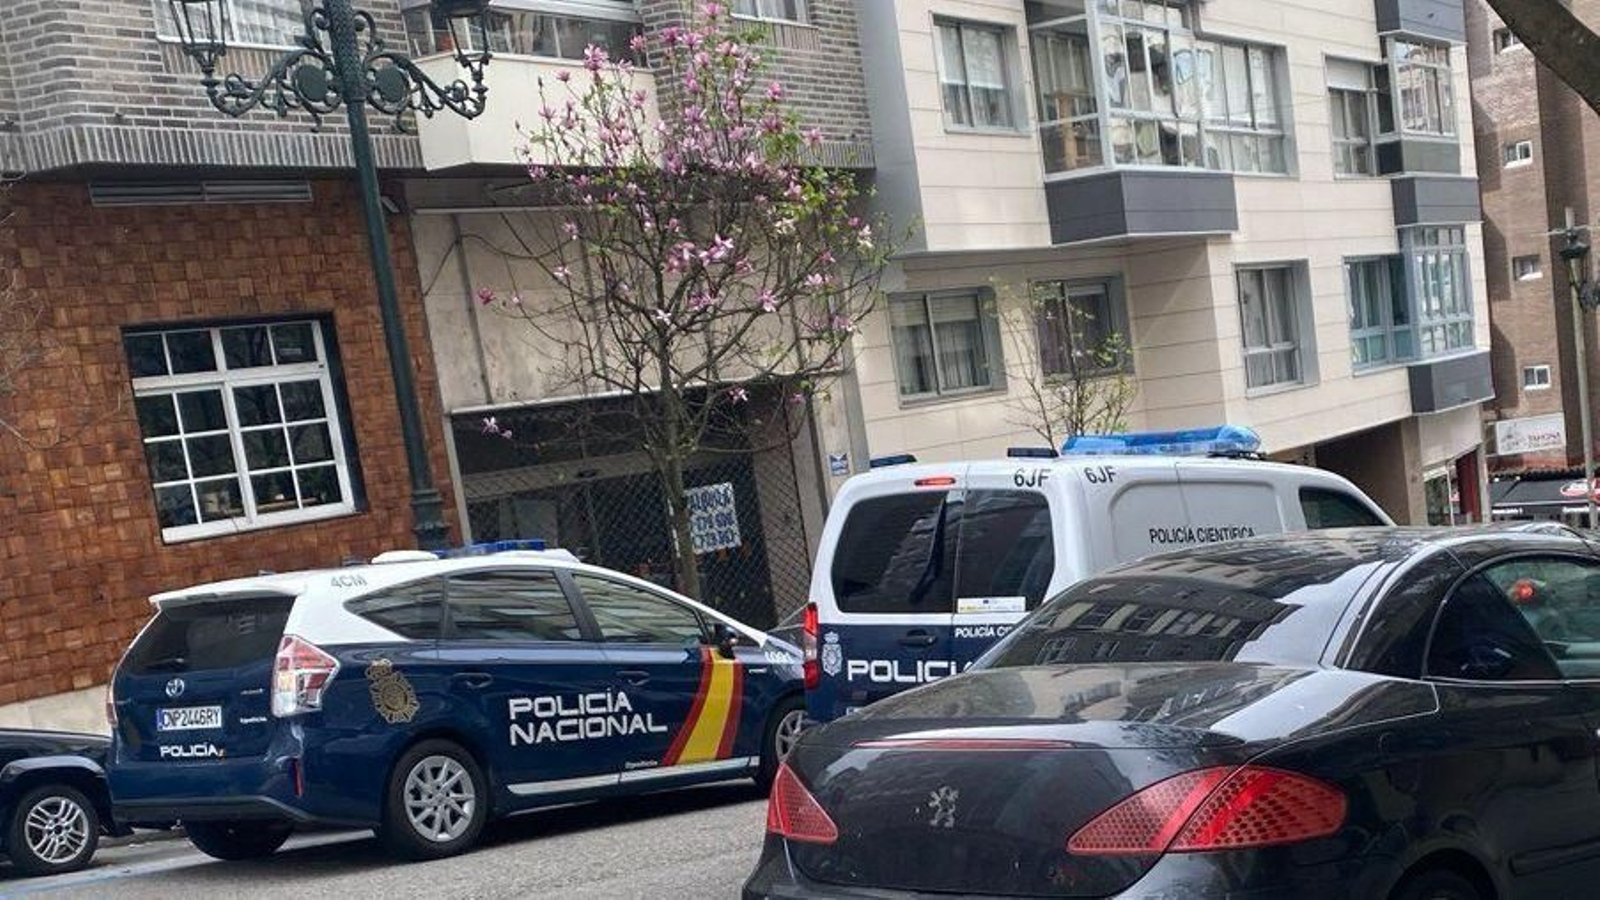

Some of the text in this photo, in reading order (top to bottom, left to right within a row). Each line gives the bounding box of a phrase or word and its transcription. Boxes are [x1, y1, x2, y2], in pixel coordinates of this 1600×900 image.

[1013, 469, 1051, 487] 6JF
[1084, 465, 1117, 484] 6JF
[1149, 526, 1196, 543] POLICÍA
[955, 625, 996, 638] POLICÍA
[508, 687, 633, 720] POLICÍA
[509, 713, 668, 746] NACIONAL
[160, 742, 219, 757] POLICÍA
